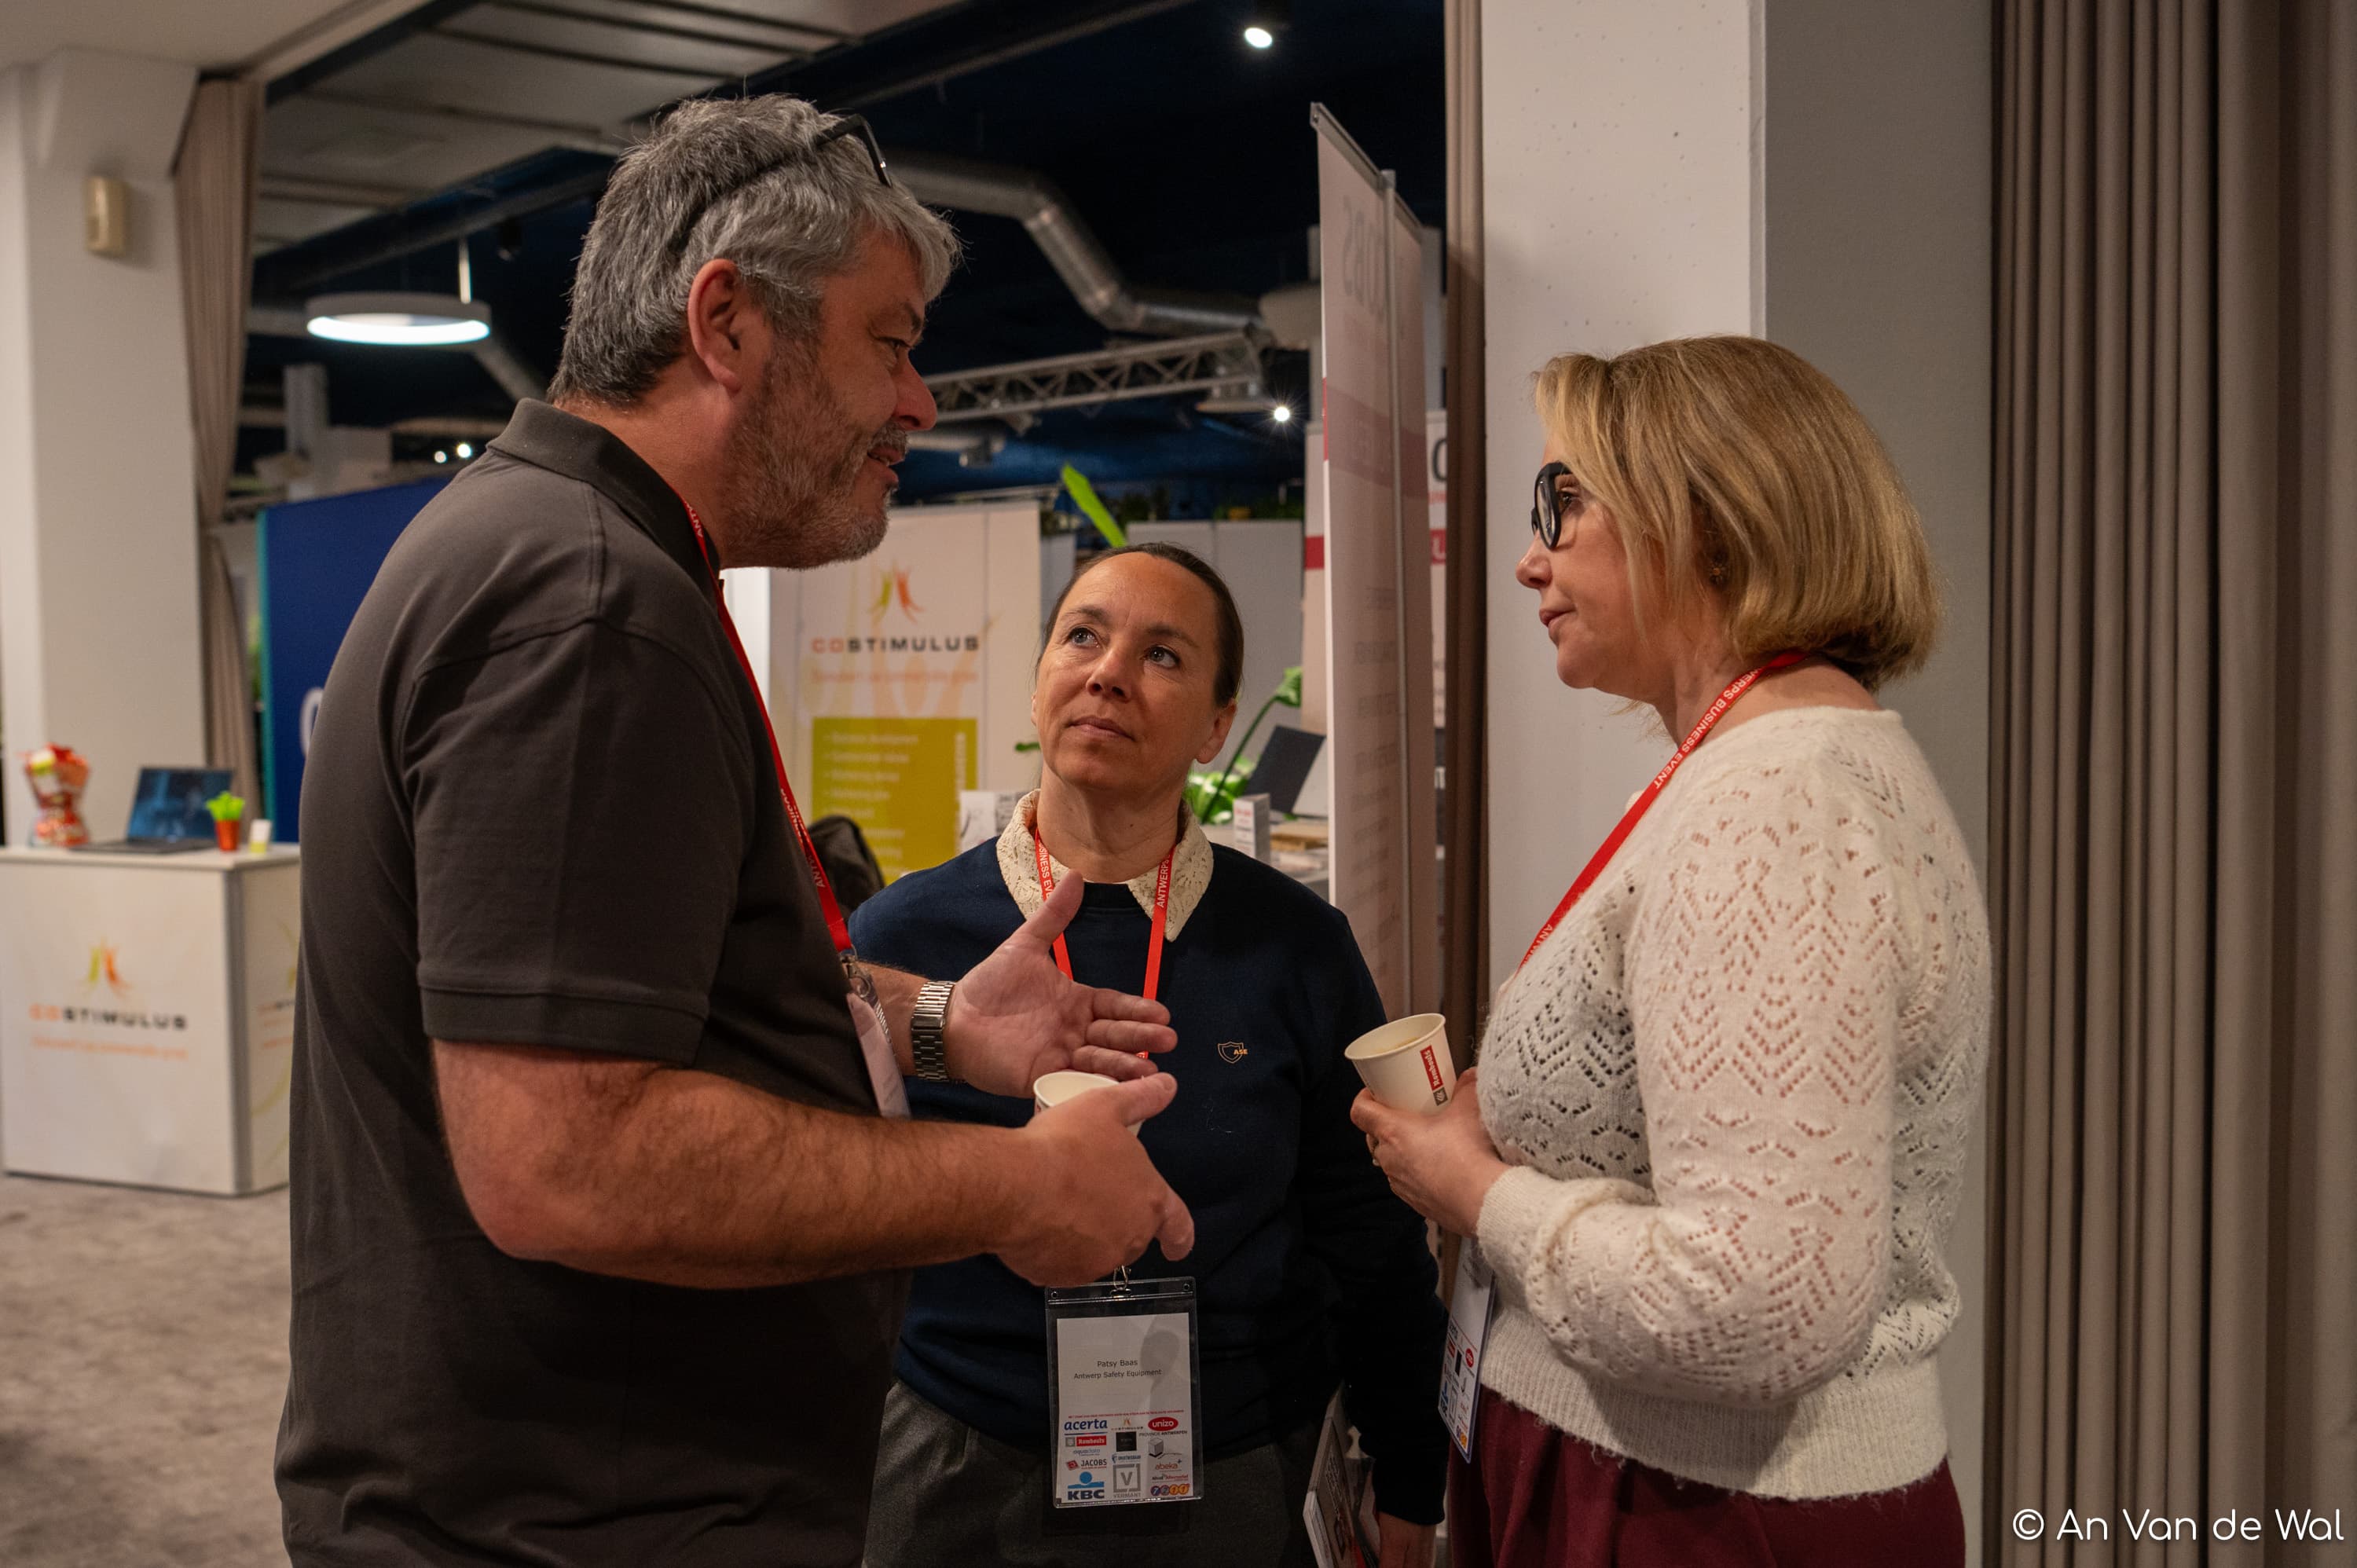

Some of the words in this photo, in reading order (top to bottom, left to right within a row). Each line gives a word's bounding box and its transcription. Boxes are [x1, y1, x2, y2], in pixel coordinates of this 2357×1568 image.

[812, 635, 980, 654] COSTIMULUS
[1682, 698, 1726, 753] BUSINESS
[1654, 753, 1683, 789] EVENT
[1097, 1360, 1117, 1368] Patsy
[1064, 1418, 1108, 1431] acerta
[1068, 1489, 1105, 1500] KBC
